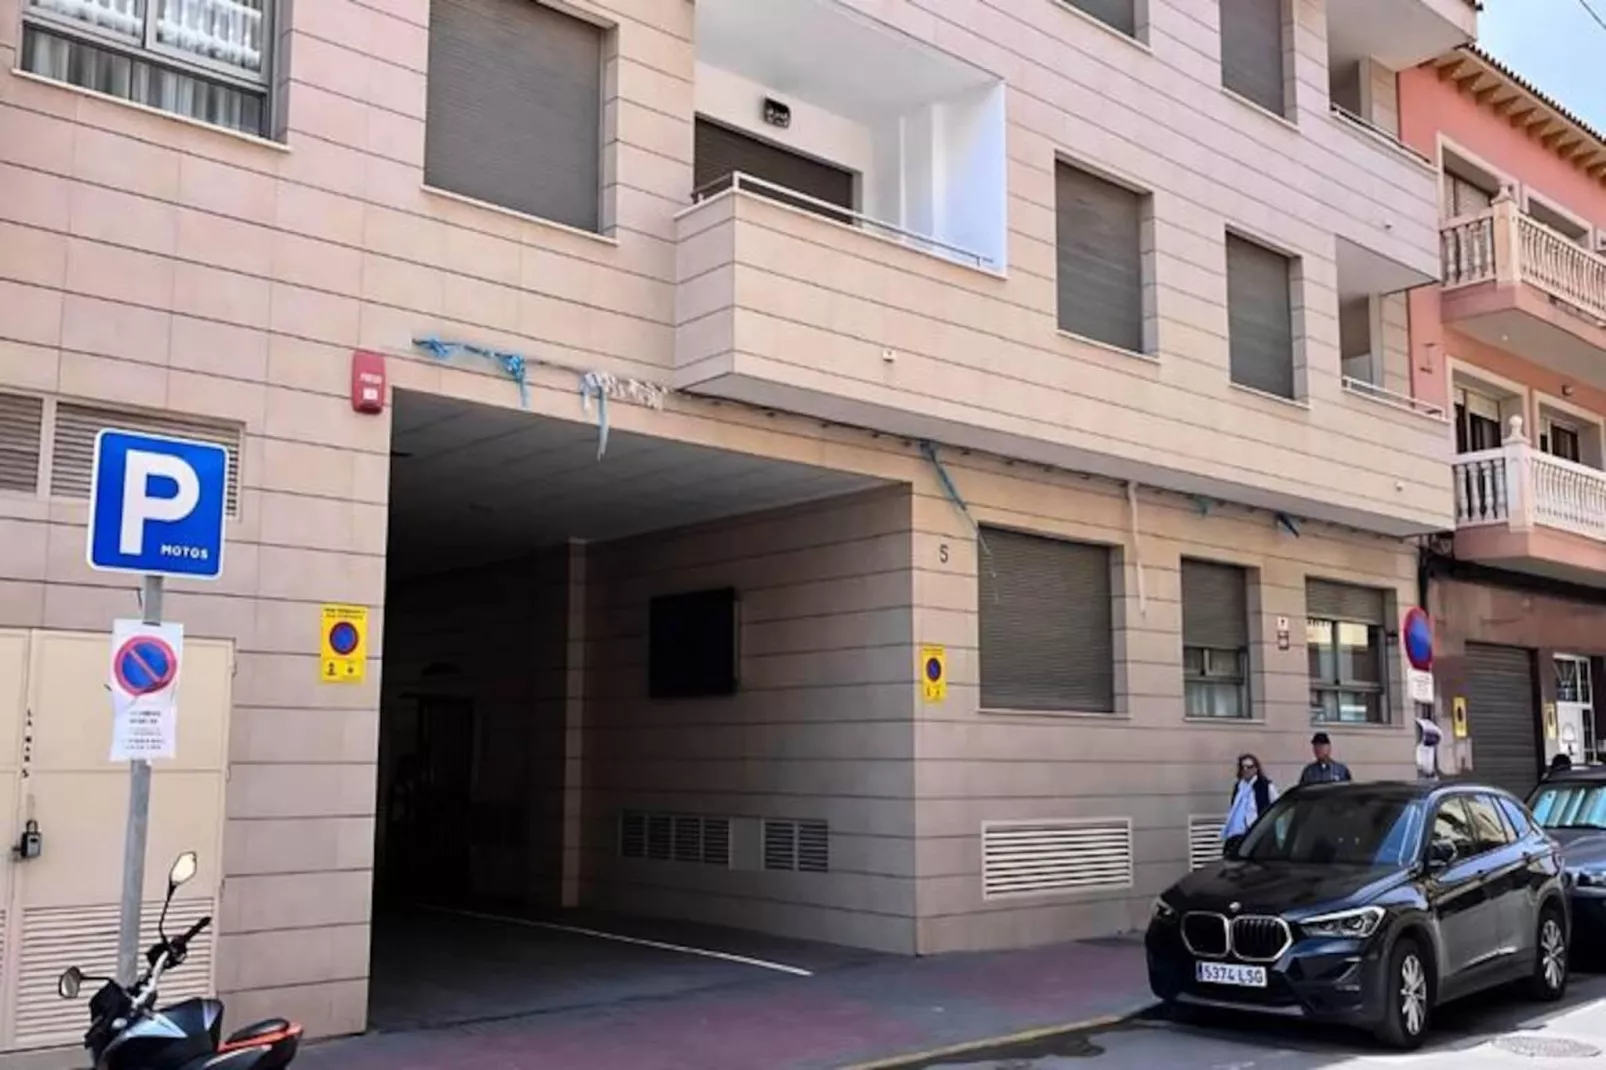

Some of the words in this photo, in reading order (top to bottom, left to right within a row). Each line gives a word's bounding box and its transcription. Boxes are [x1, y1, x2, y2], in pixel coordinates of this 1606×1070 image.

[119, 449, 201, 555] P
[161, 544, 208, 560] MOTOS
[939, 544, 948, 563] 5
[1204, 966, 1235, 981] 5374
[1238, 968, 1263, 984] LSG
